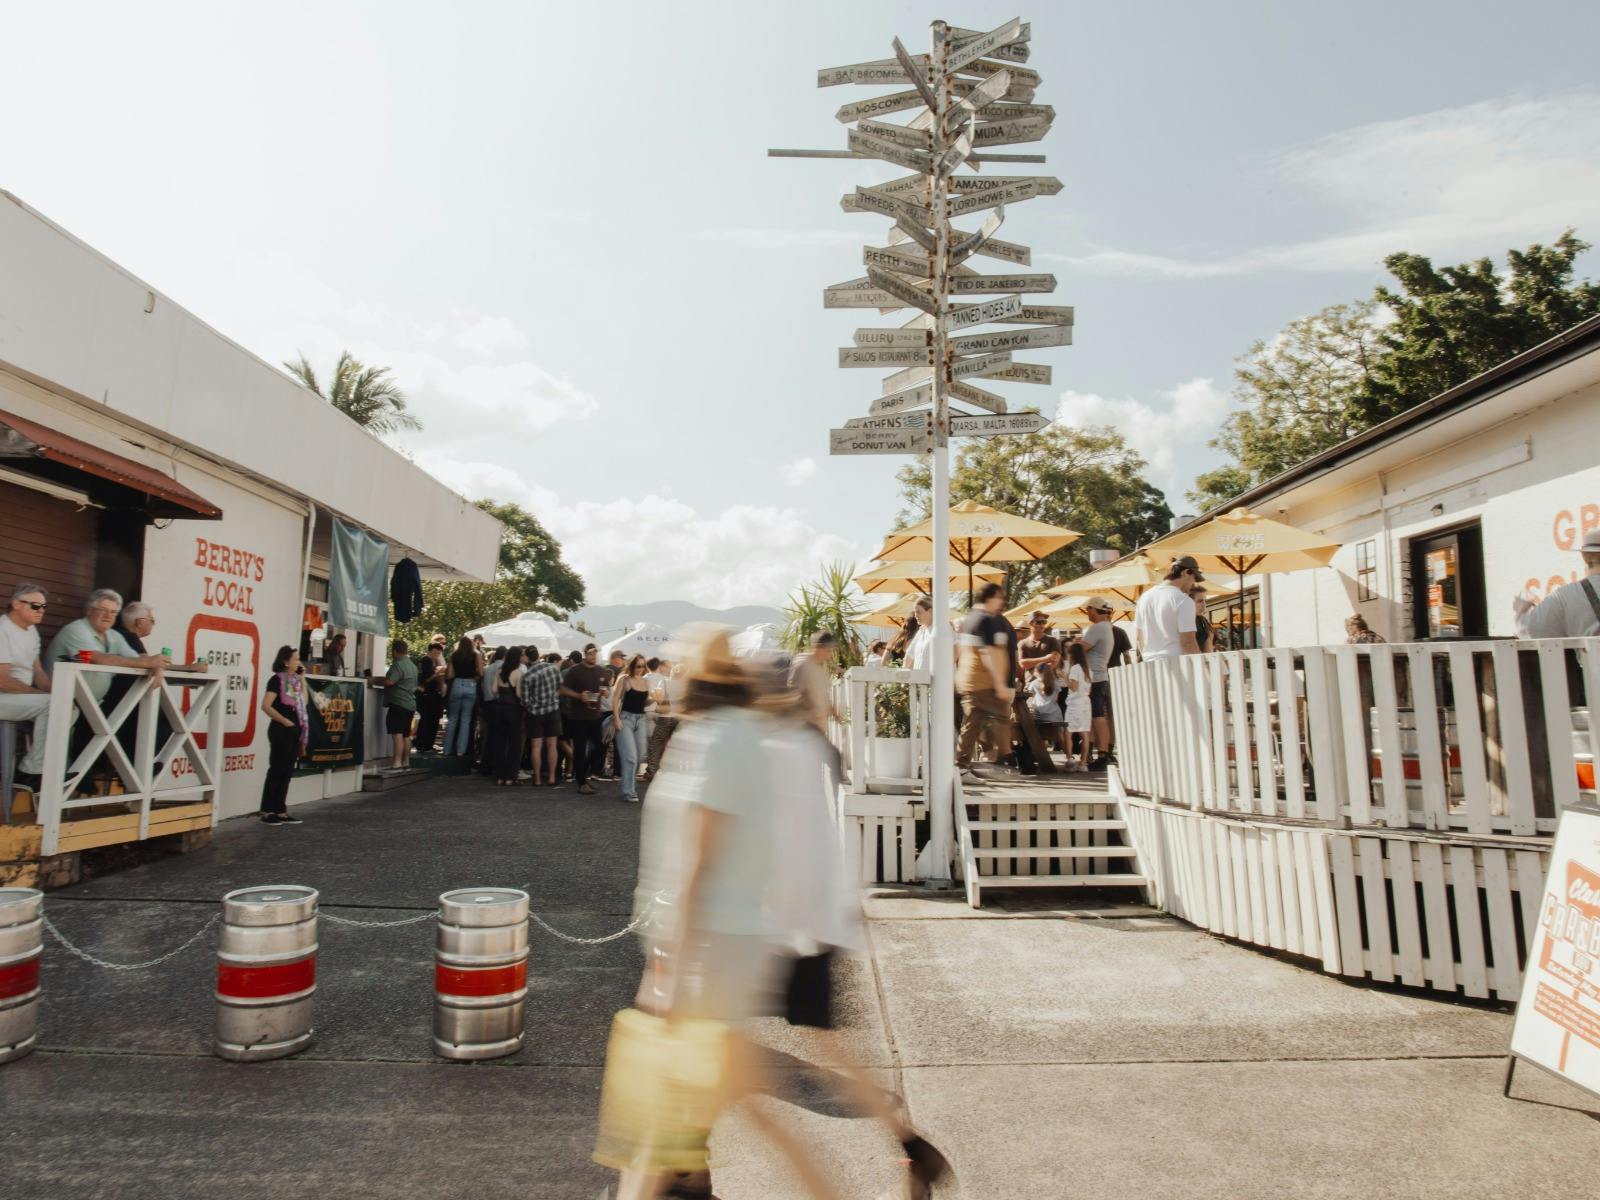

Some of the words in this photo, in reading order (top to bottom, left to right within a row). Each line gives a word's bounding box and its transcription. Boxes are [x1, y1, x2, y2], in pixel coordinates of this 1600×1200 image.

[856, 97, 902, 116] MOSCOW
[860, 123, 897, 138] SOWETO
[884, 181, 914, 193] MAHAL
[954, 180, 998, 190] AMAZON
[953, 198, 976, 212] LORD
[977, 190, 1004, 206] HOWE
[866, 250, 900, 266] PERTH
[956, 281, 974, 290] RIO
[975, 280, 985, 290] DE
[988, 279, 1026, 289] JANEIRO
[952, 307, 980, 325] TANNED
[981, 301, 1004, 320] HIDES
[857, 333, 895, 344] ULURU
[955, 339, 989, 351] GRAND
[990, 335, 1030, 348] CANYON
[853, 351, 876, 362] SILOS
[953, 360, 988, 377] MANILLA
[1005, 367, 1031, 379] LOUIS
[880, 396, 905, 409] PARIS
[862, 416, 902, 429] ATHENS
[983, 419, 1006, 430] MALTA
[851, 441, 884, 450] DONUT
[886, 441, 907, 449] VAN
[194, 537, 265, 582] BERRY'S
[203, 576, 254, 615] LOCAL
[207, 650, 241, 667] GREAT
[224, 754, 256, 772] BERRY
